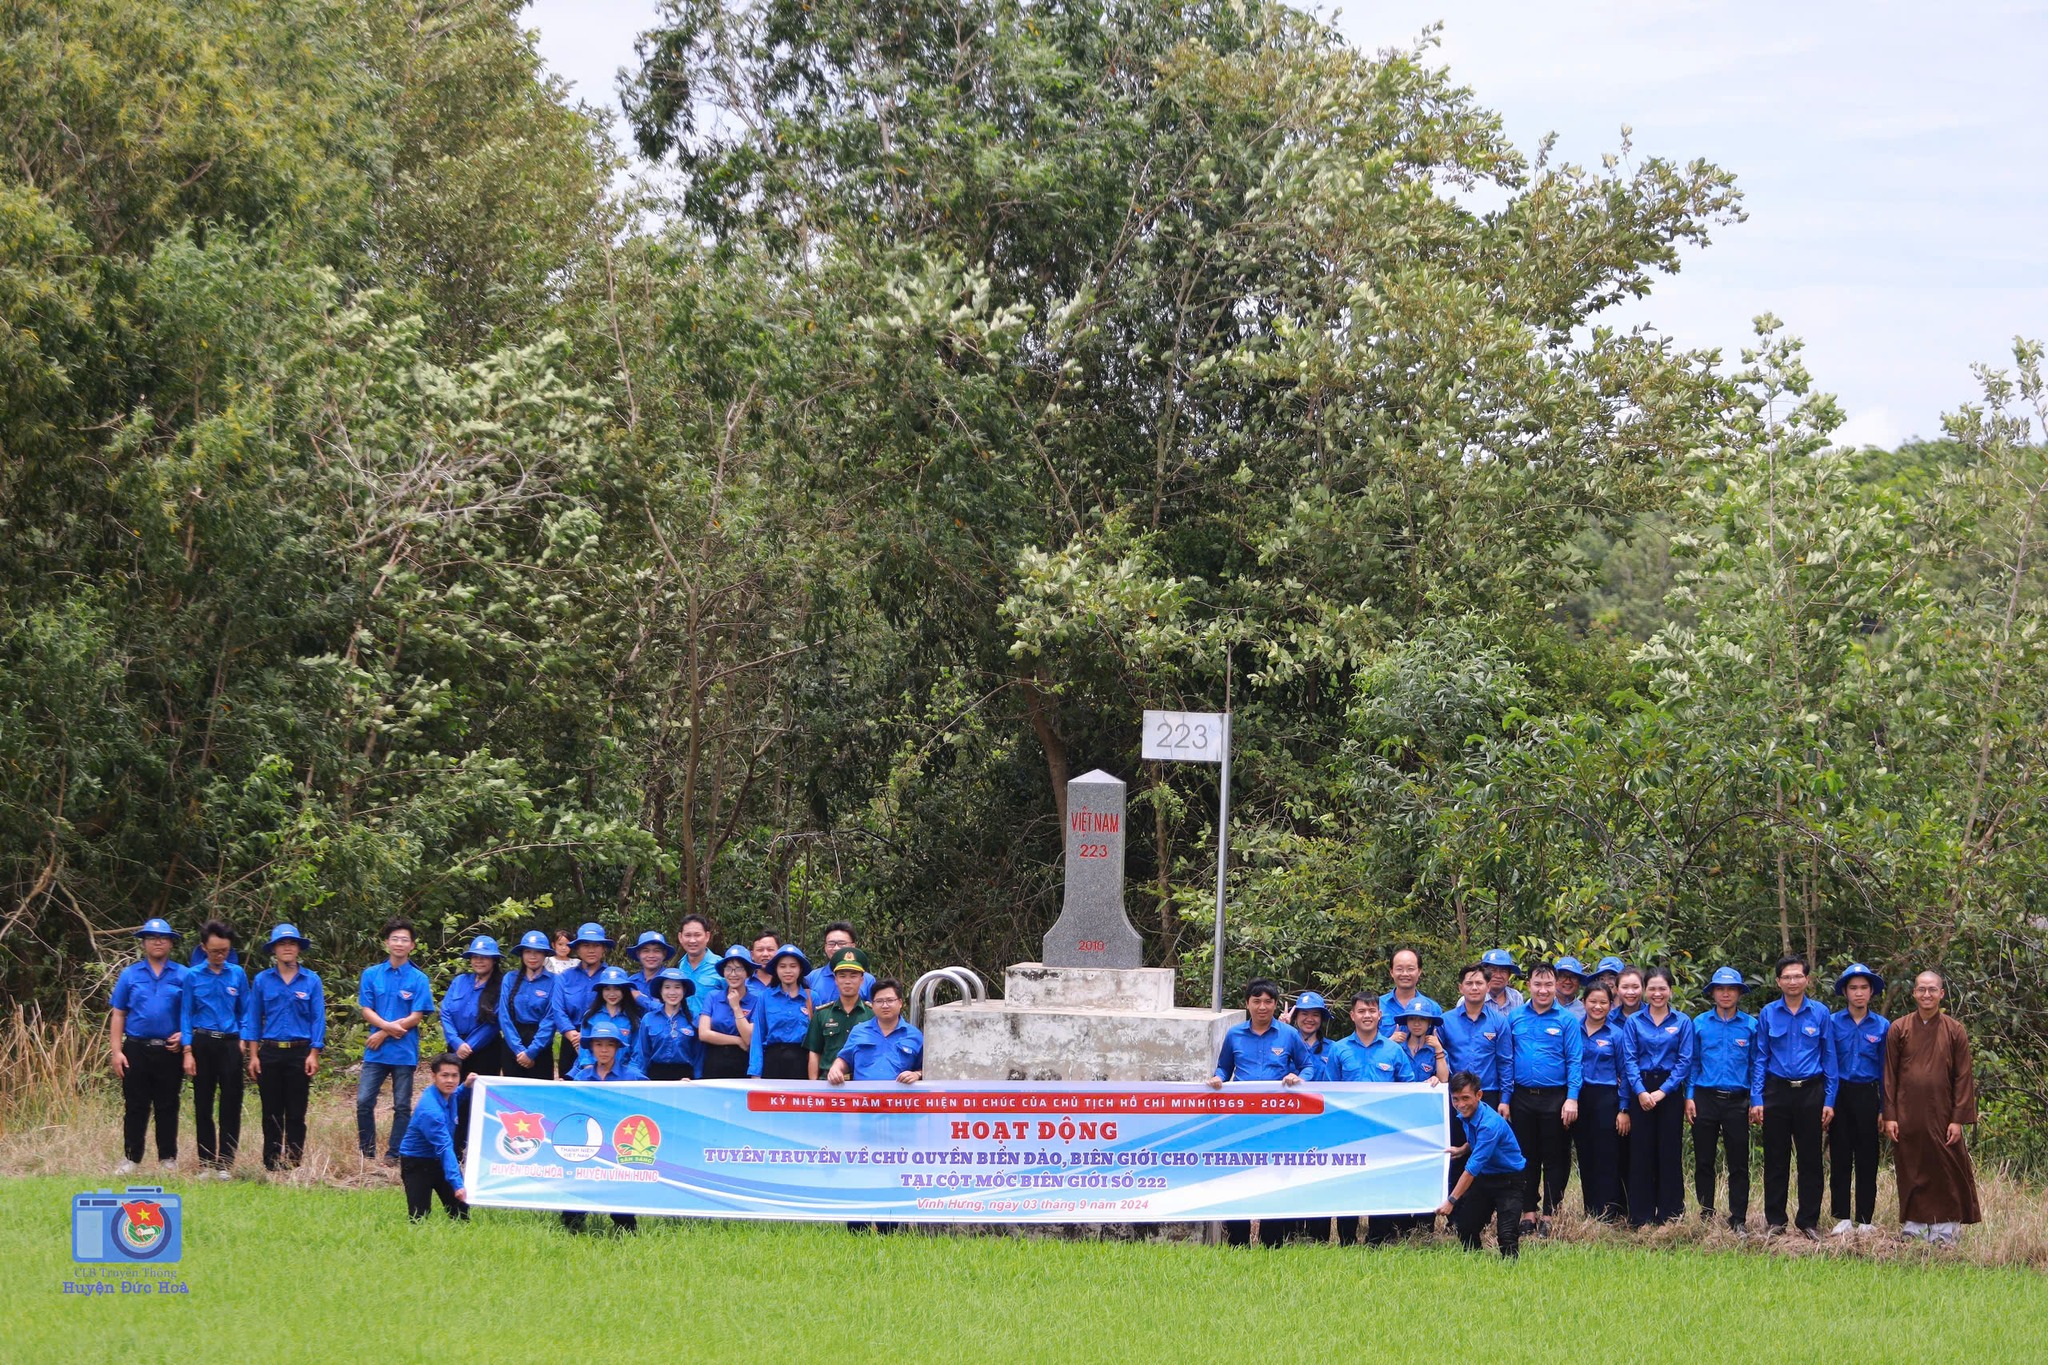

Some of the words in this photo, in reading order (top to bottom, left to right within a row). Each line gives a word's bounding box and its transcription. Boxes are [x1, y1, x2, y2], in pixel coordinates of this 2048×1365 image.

[1156, 723, 1208, 749] 223
[1071, 806, 1092, 837] VIỆT
[1094, 813, 1119, 833] NAM
[1079, 844, 1108, 858] 223
[792, 1096, 825, 1108] NIỆM
[831, 1098, 846, 1107] 55
[852, 1096, 880, 1107] NĂM
[886, 1098, 920, 1109] THỰC
[926, 1096, 957, 1109] HIỆN
[963, 1098, 976, 1107] DI
[982, 1096, 1016, 1107] CHÚC
[1022, 1095, 1047, 1107] CỦA
[1053, 1095, 1078, 1107] CHỦ
[1084, 1098, 1114, 1109] TỊCH
[1120, 1095, 1137, 1107] HỒ
[1143, 1096, 1165, 1107] CHÍ
[1261, 1098, 1301, 1109] 2024)
[951, 1121, 1029, 1144] HOẠT
[1037, 1116, 1117, 1144] ĐỘNG
[704, 1146, 765, 1162] TUYÊN
[768, 1146, 841, 1163] TRUYỀN
[845, 1146, 869, 1164] VỀ
[871, 1147, 908, 1164] CHỦ
[911, 1146, 973, 1165] QUYỀN
[977, 1145, 1020, 1165] BIỂN
[1024, 1148, 1067, 1168] ĐẢO,
[1070, 1148, 1114, 1165] BIÊN
[1117, 1148, 1158, 1165] GIỚI
[1161, 1153, 1198, 1166] CHO
[1202, 1153, 1268, 1166] THANH
[1272, 1147, 1328, 1166] THIẾU
[1331, 1153, 1367, 1166] NHI
[491, 1164, 521, 1177] HUYỆN
[576, 1167, 608, 1180] HUYỆN
[609, 1167, 632, 1181] VĨNH
[632, 1169, 659, 1182] HƯNG
[901, 1174, 933, 1190] TẠI
[936, 1171, 972, 1190] CỘT
[975, 1170, 1017, 1187] MỐC
[1020, 1171, 1064, 1187] BIÊN
[1067, 1171, 1108, 1188] GIỚI
[1111, 1170, 1134, 1188] SỐ
[1137, 1177, 1167, 1188] 222
[948, 1199, 985, 1211] Hưng,
[989, 1199, 1020, 1212] ngày
[1023, 1199, 1037, 1209] 03
[1041, 1199, 1076, 1211] tháng
[1079, 1200, 1087, 1209] 9
[1090, 1200, 1116, 1209] năm
[1120, 1200, 1149, 1209] 2024
